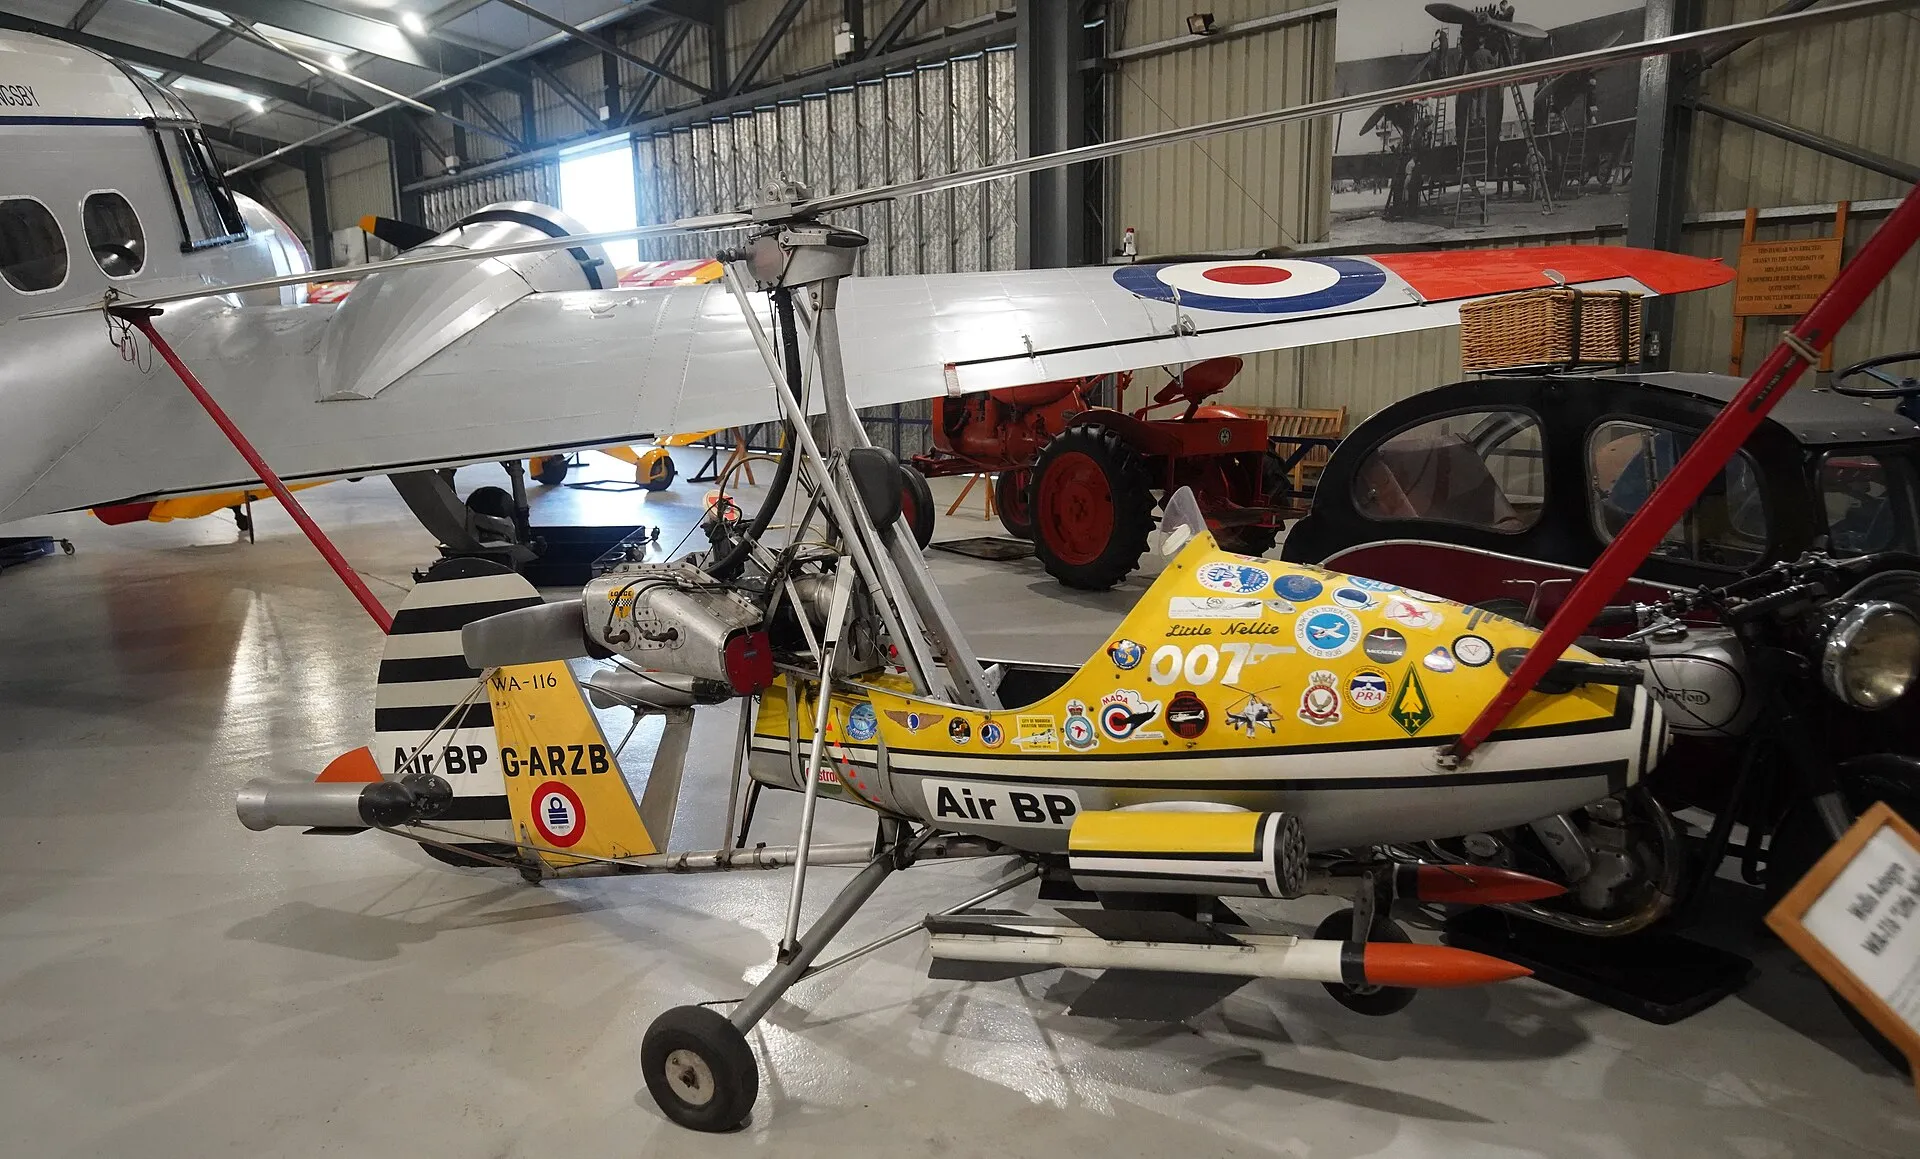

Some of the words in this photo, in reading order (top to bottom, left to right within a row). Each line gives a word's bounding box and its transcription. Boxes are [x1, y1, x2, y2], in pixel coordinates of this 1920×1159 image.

[1165, 624, 1212, 637] Little
[1221, 622, 1280, 636] Nellie
[1149, 643, 1251, 685] 007
[492, 672, 557, 692] WA-116
[1355, 691, 1382, 701] PRA
[1651, 687, 1704, 703] Norton
[394, 746, 433, 774] Air
[443, 745, 488, 774] BP
[501, 744, 610, 777] G-ARZB
[937, 786, 997, 820] Air
[1009, 791, 1076, 825] BP
